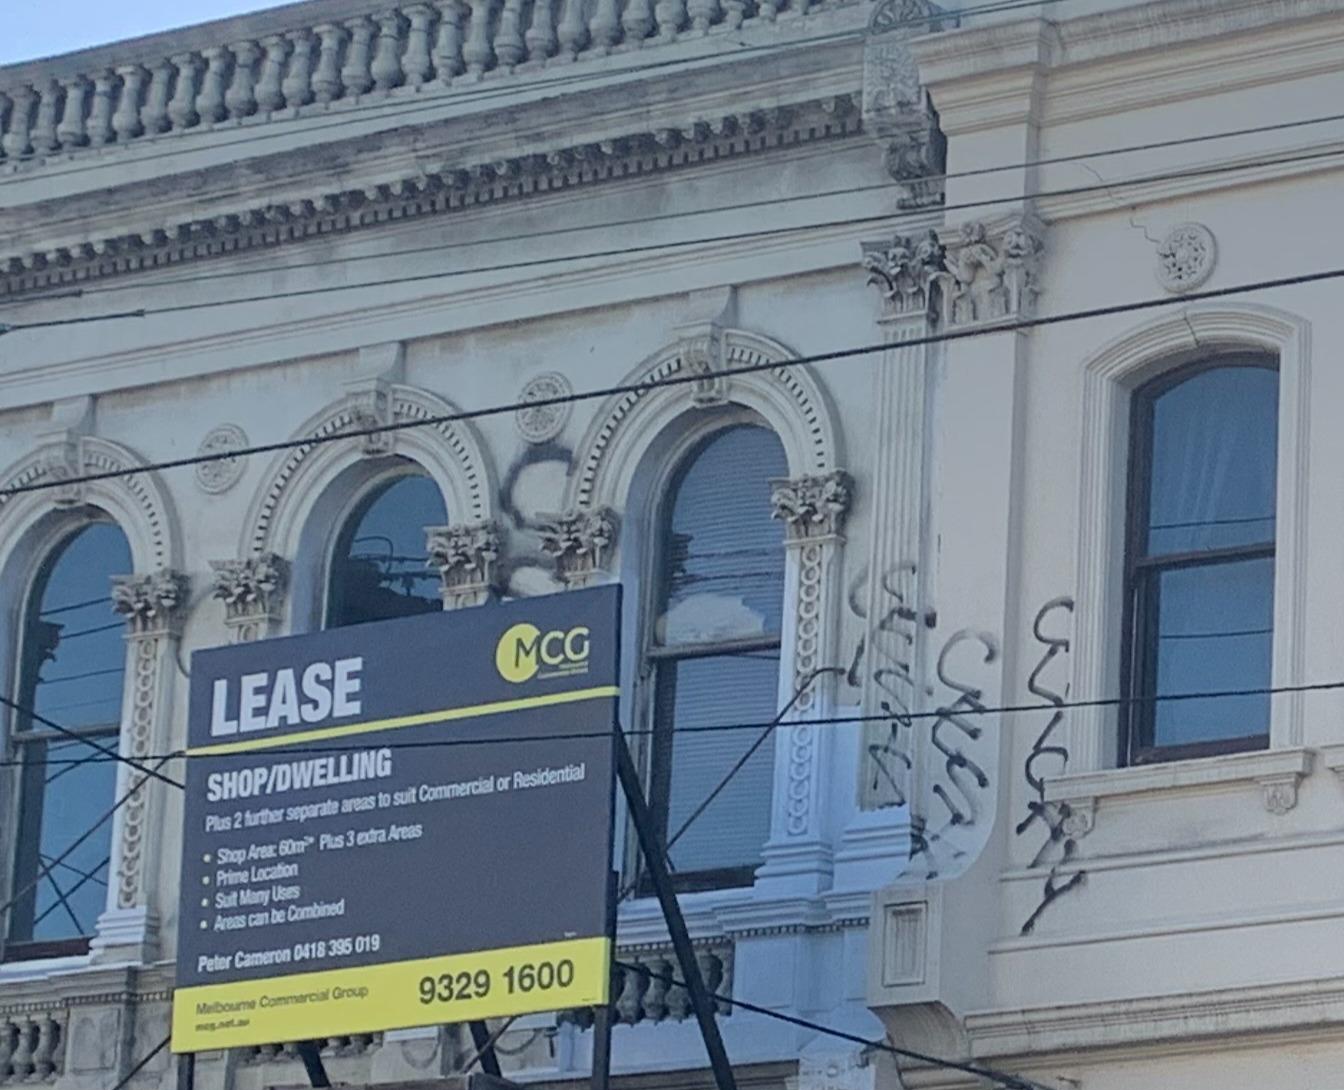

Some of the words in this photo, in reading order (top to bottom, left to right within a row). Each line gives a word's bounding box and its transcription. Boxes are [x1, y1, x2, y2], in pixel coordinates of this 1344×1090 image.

[514, 626, 590, 669] MCG
[211, 657, 363, 737] LEASE
[206, 748, 392, 801] SHOP/DWELLING
[205, 815, 231, 832] Plus
[233, 812, 242, 829] 2
[244, 807, 284, 828] further
[286, 800, 339, 823] separate
[341, 795, 376, 812] areas
[378, 791, 391, 809] to
[393, 787, 417, 806] suit
[418, 776, 494, 802] Commercial
[496, 779, 511, 792] or
[513, 763, 585, 790] Residential
[217, 848, 247, 865] Shop
[319, 833, 345, 850] Plus
[346, 831, 355, 847] 3
[357, 828, 387, 845] extra
[388, 824, 423, 841] Areas
[216, 869, 249, 887] Prime
[251, 862, 299, 883] Location
[213, 914, 247, 932] Areas
[248, 913, 270, 928] can
[271, 908, 286, 923] be
[287, 899, 345, 922] Combined
[215, 892, 239, 909] Suit
[240, 888, 270, 907] Many
[272, 884, 300, 902] Uses
[197, 956, 232, 973] Peter
[234, 948, 291, 969] Cameron
[293, 942, 326, 961] 0418
[354, 934, 381, 953] 019
[195, 998, 257, 1016] Melbourne
[259, 989, 330, 1010] Commercial
[332, 986, 370, 1003] Group
[419, 969, 492, 1005] 9329
[502, 959, 575, 996] 1600
